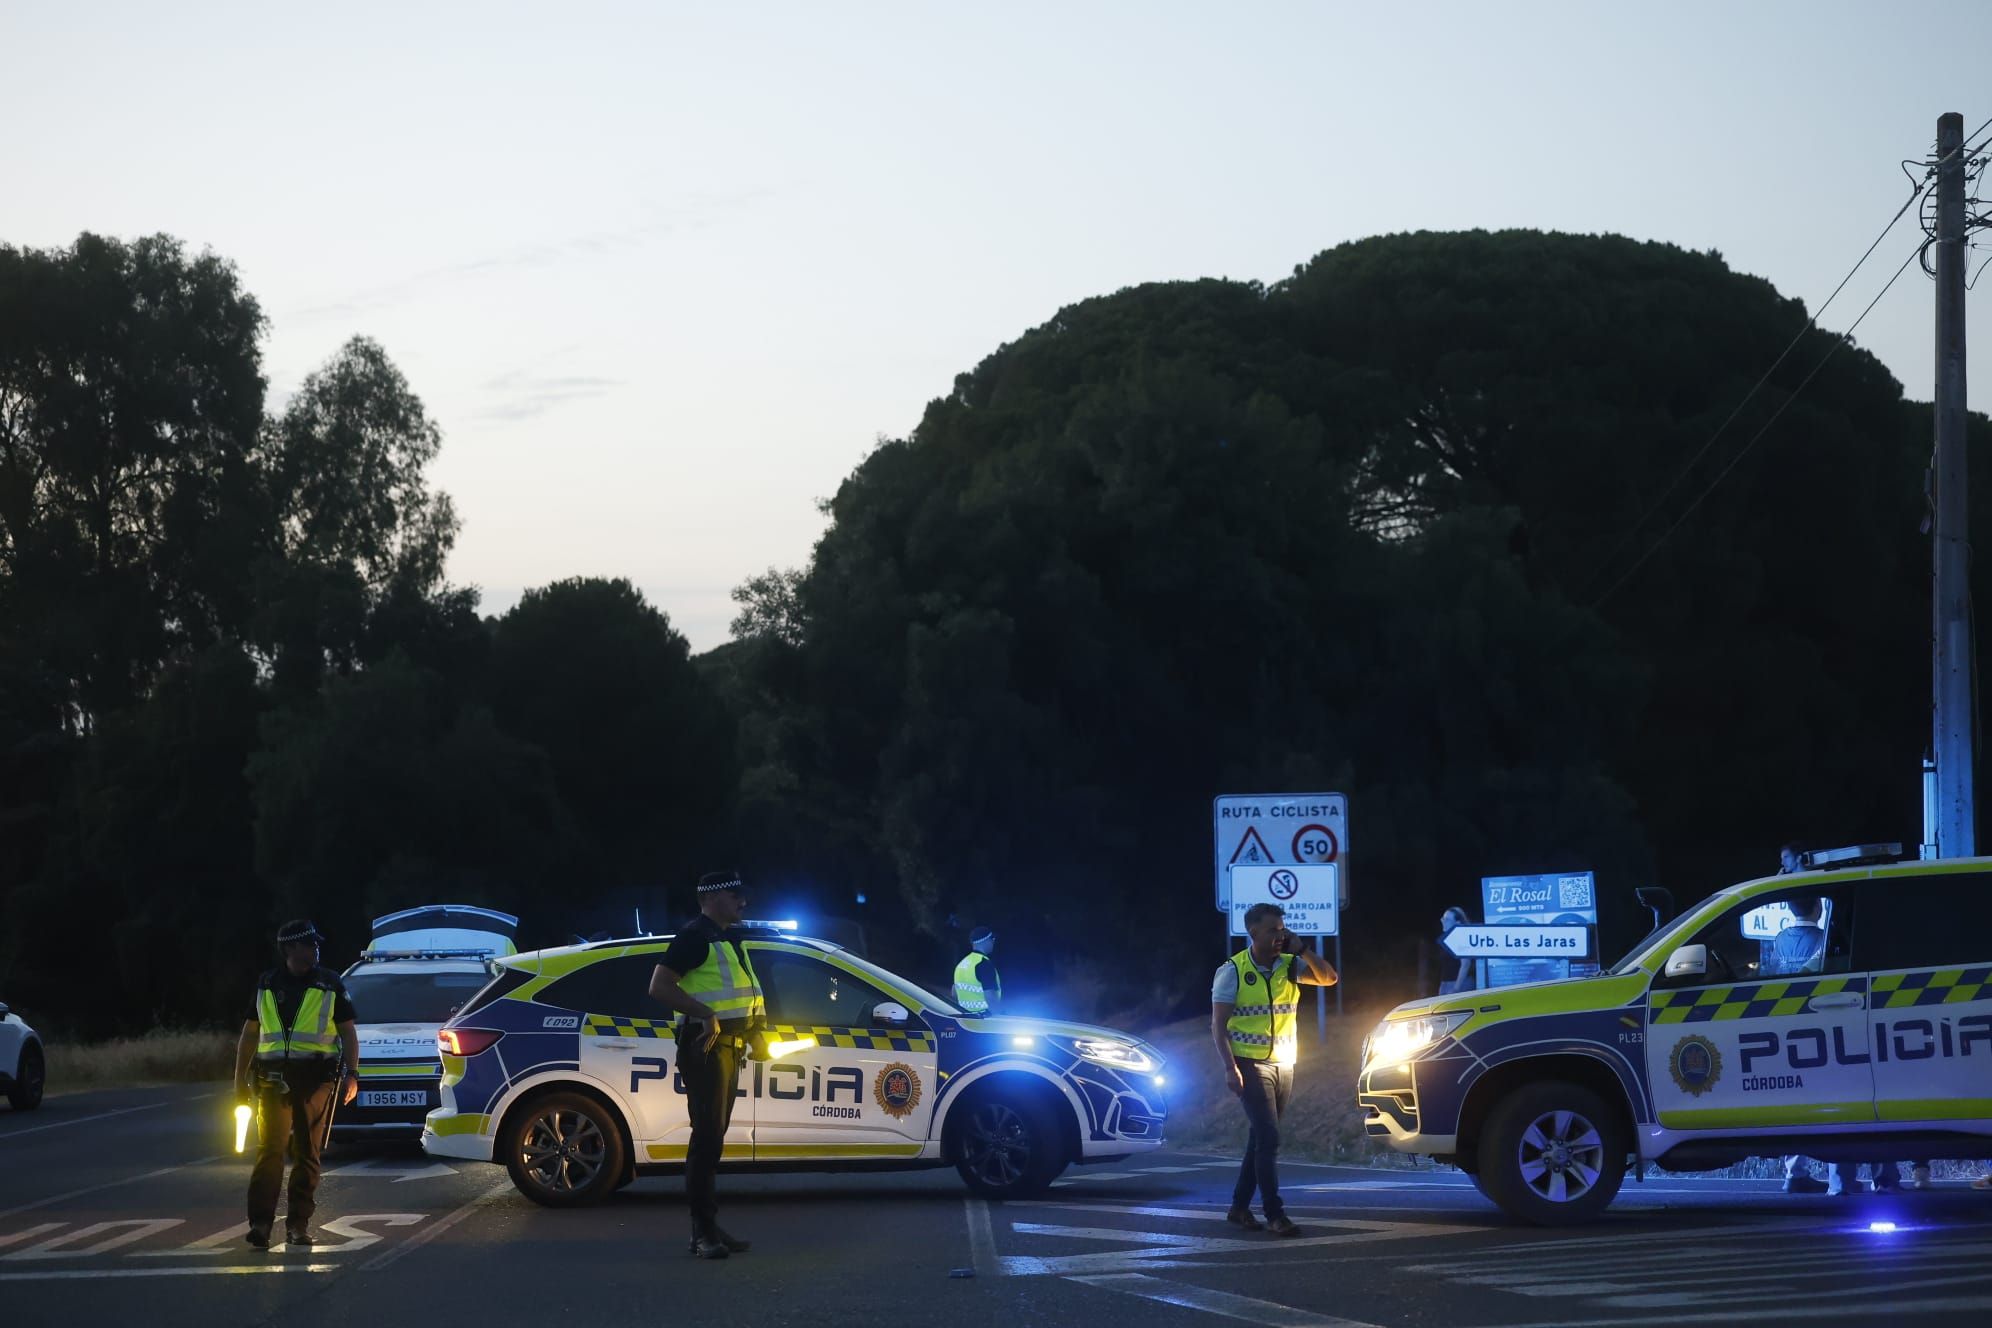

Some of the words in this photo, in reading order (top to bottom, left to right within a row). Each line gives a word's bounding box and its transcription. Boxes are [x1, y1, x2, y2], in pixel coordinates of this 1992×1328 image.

[1222, 807, 1261, 818] RUTA
[1270, 805, 1339, 818] CICLISTA
[1303, 840, 1328, 855] 50
[1488, 888, 1506, 904] El
[1510, 885, 1552, 903] Rosal
[1753, 915, 1768, 930] AL
[1469, 934, 1499, 947] Urb.
[1505, 934, 1530, 947] Las
[1537, 934, 1576, 947] Jaras
[1618, 1032, 1643, 1044] PL23
[1742, 1074, 1803, 1092] CÓRDOBA
[367, 1093, 397, 1104] 1956
[401, 1093, 424, 1104] MSY
[812, 1104, 861, 1120] CÓRDOBA
